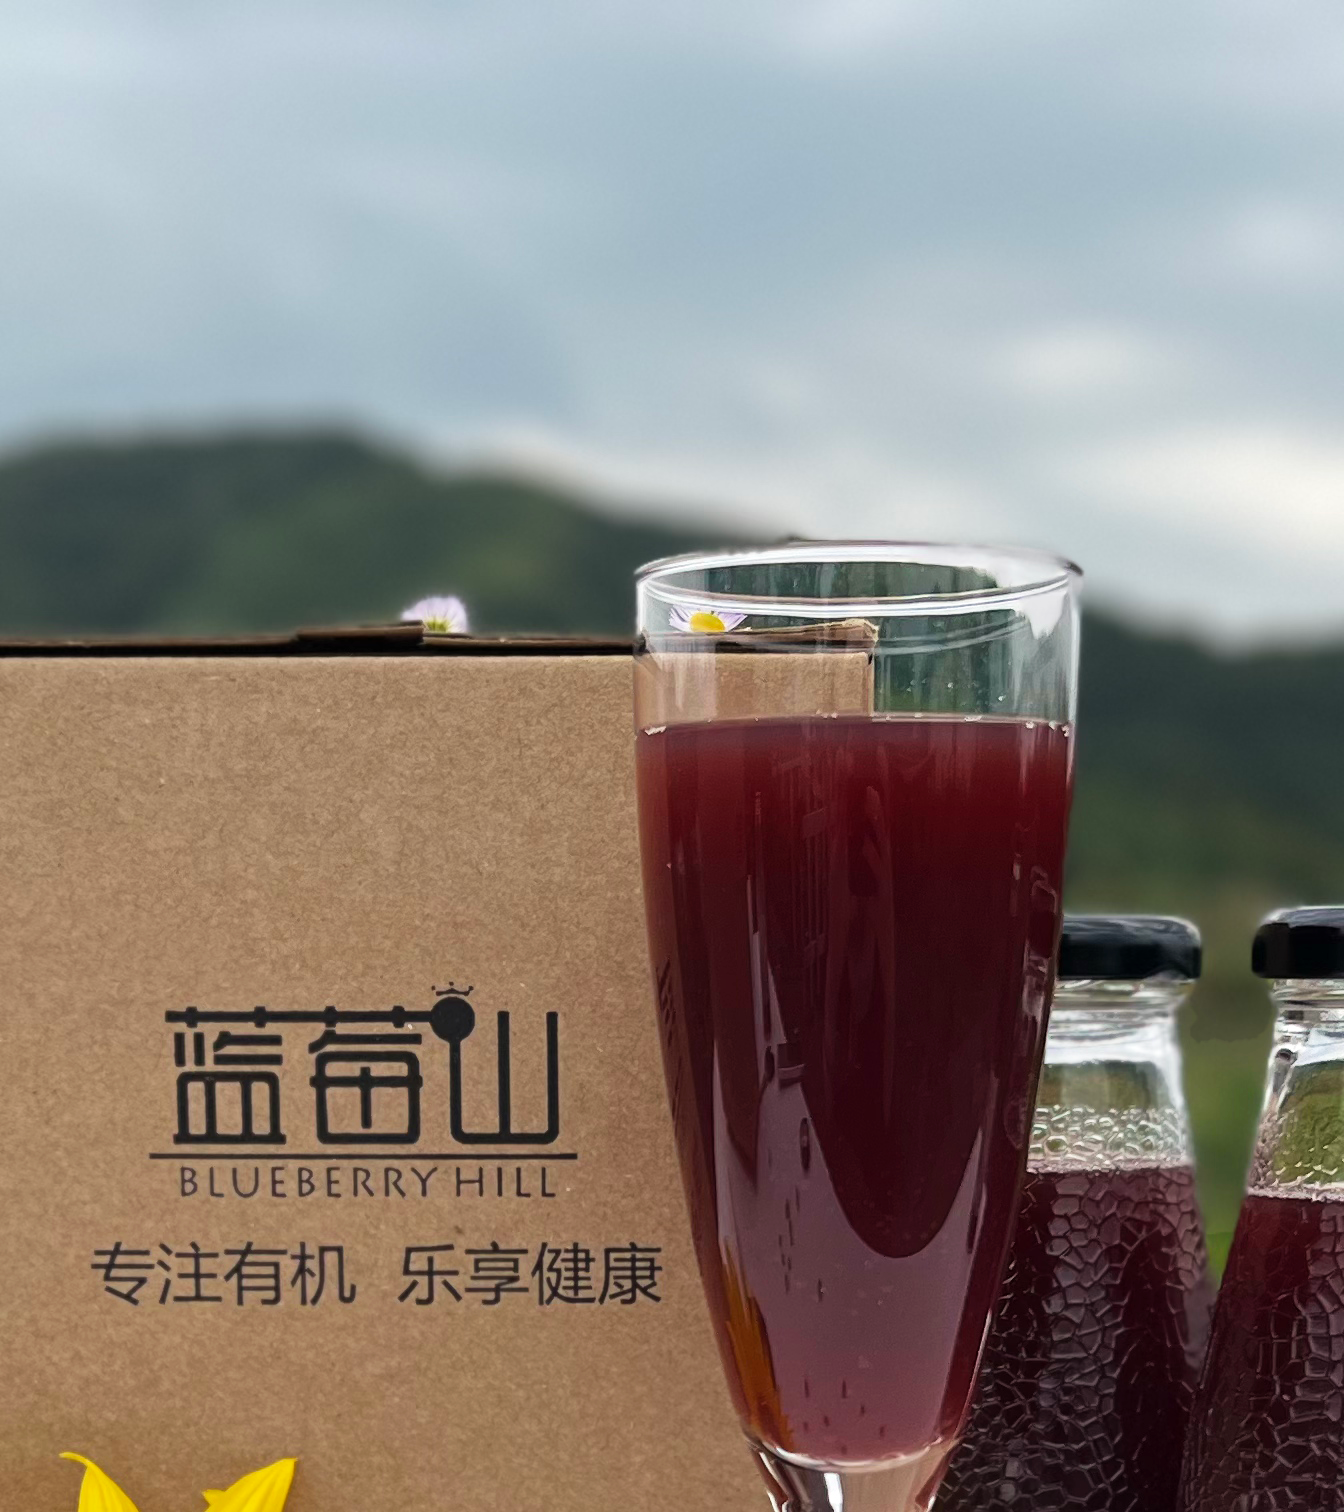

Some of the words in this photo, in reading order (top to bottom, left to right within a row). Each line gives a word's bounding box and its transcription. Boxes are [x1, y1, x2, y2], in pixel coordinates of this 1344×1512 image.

[165, 997, 558, 1145] 蓝莓山
[180, 1166, 438, 1198] BLUEBERRY
[457, 1166, 556, 1198] HILL
[91, 1241, 356, 1306] 专注有机
[398, 1241, 663, 1306] 乐享健康
